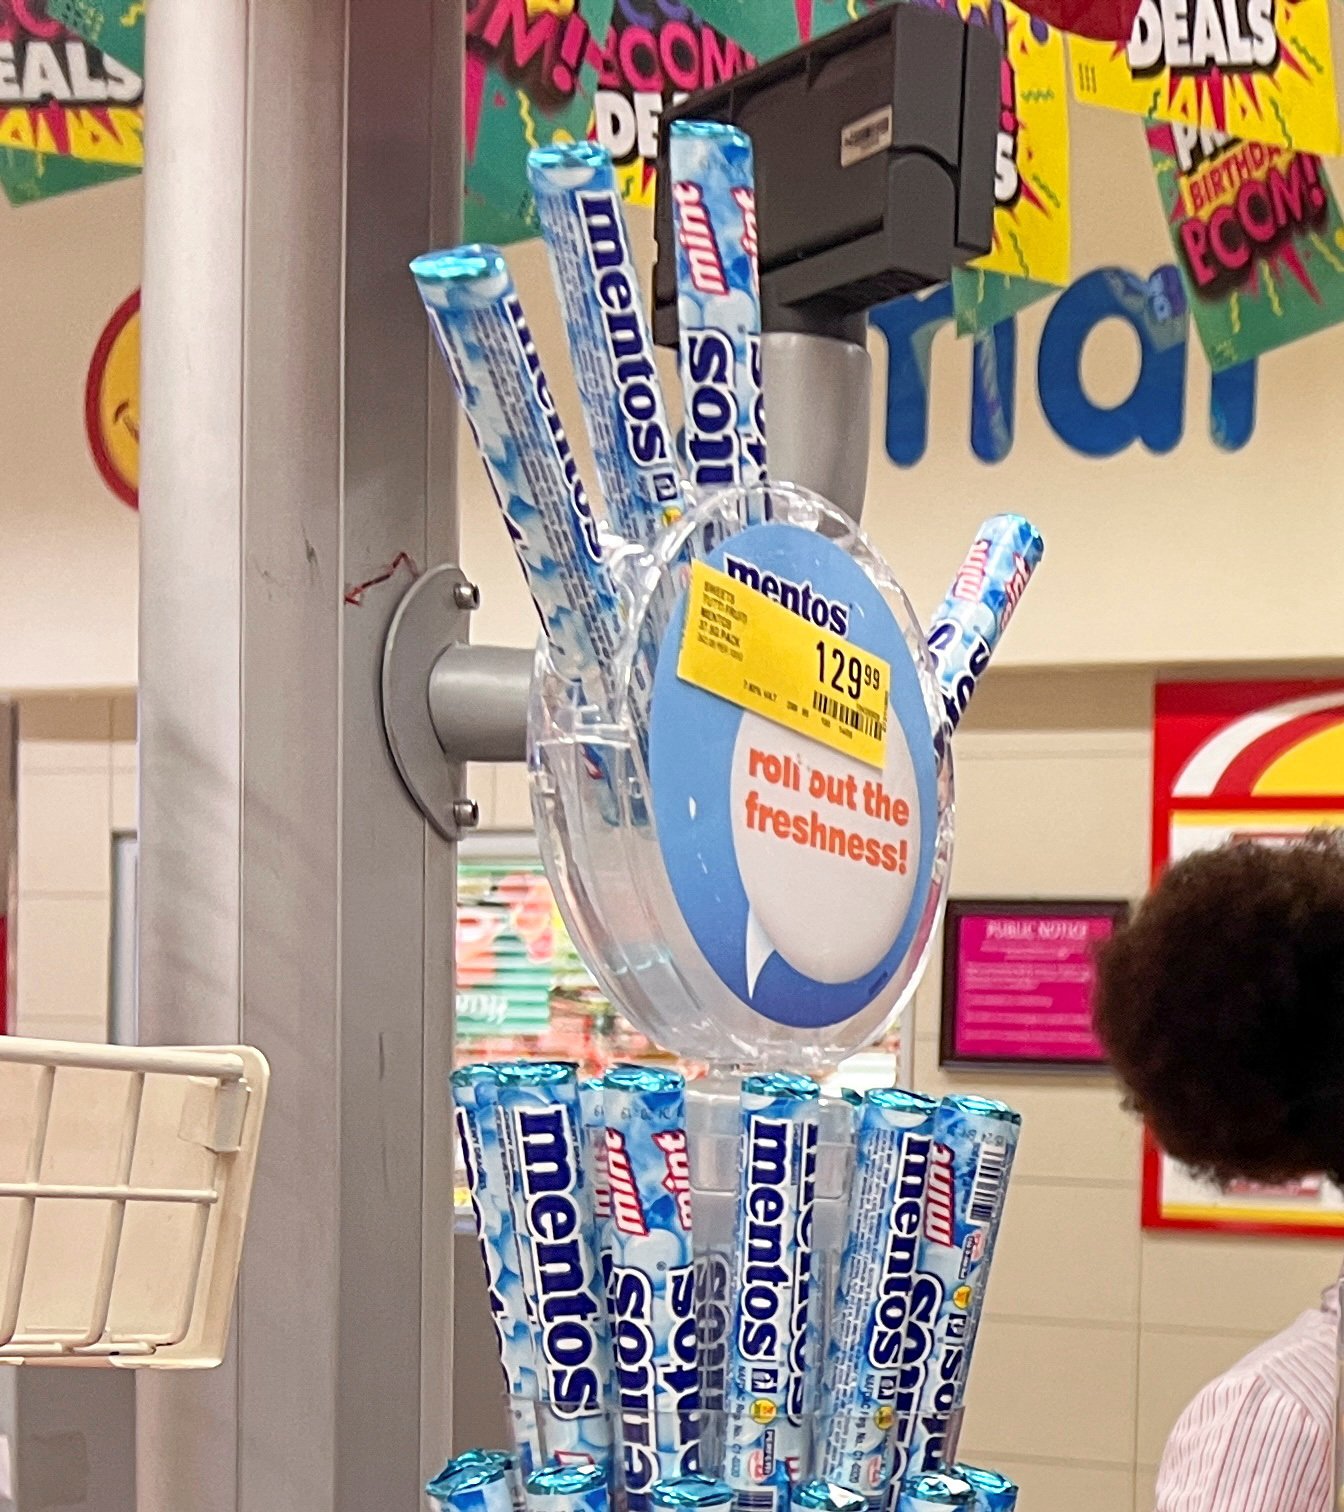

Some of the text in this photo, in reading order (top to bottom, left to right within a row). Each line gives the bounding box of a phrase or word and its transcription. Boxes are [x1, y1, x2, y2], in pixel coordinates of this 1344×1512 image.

[1127, 0, 1278, 69] DEALS
[672, 181, 729, 297] mint
[578, 190, 673, 468] mentos
[725, 556, 850, 637] mentos
[745, 790, 908, 876] freshness!
[749, 747, 910, 828] roll out the
[514, 1106, 603, 1420] mentos
[739, 1117, 792, 1364] mentos
[870, 1132, 934, 1370] mentos
